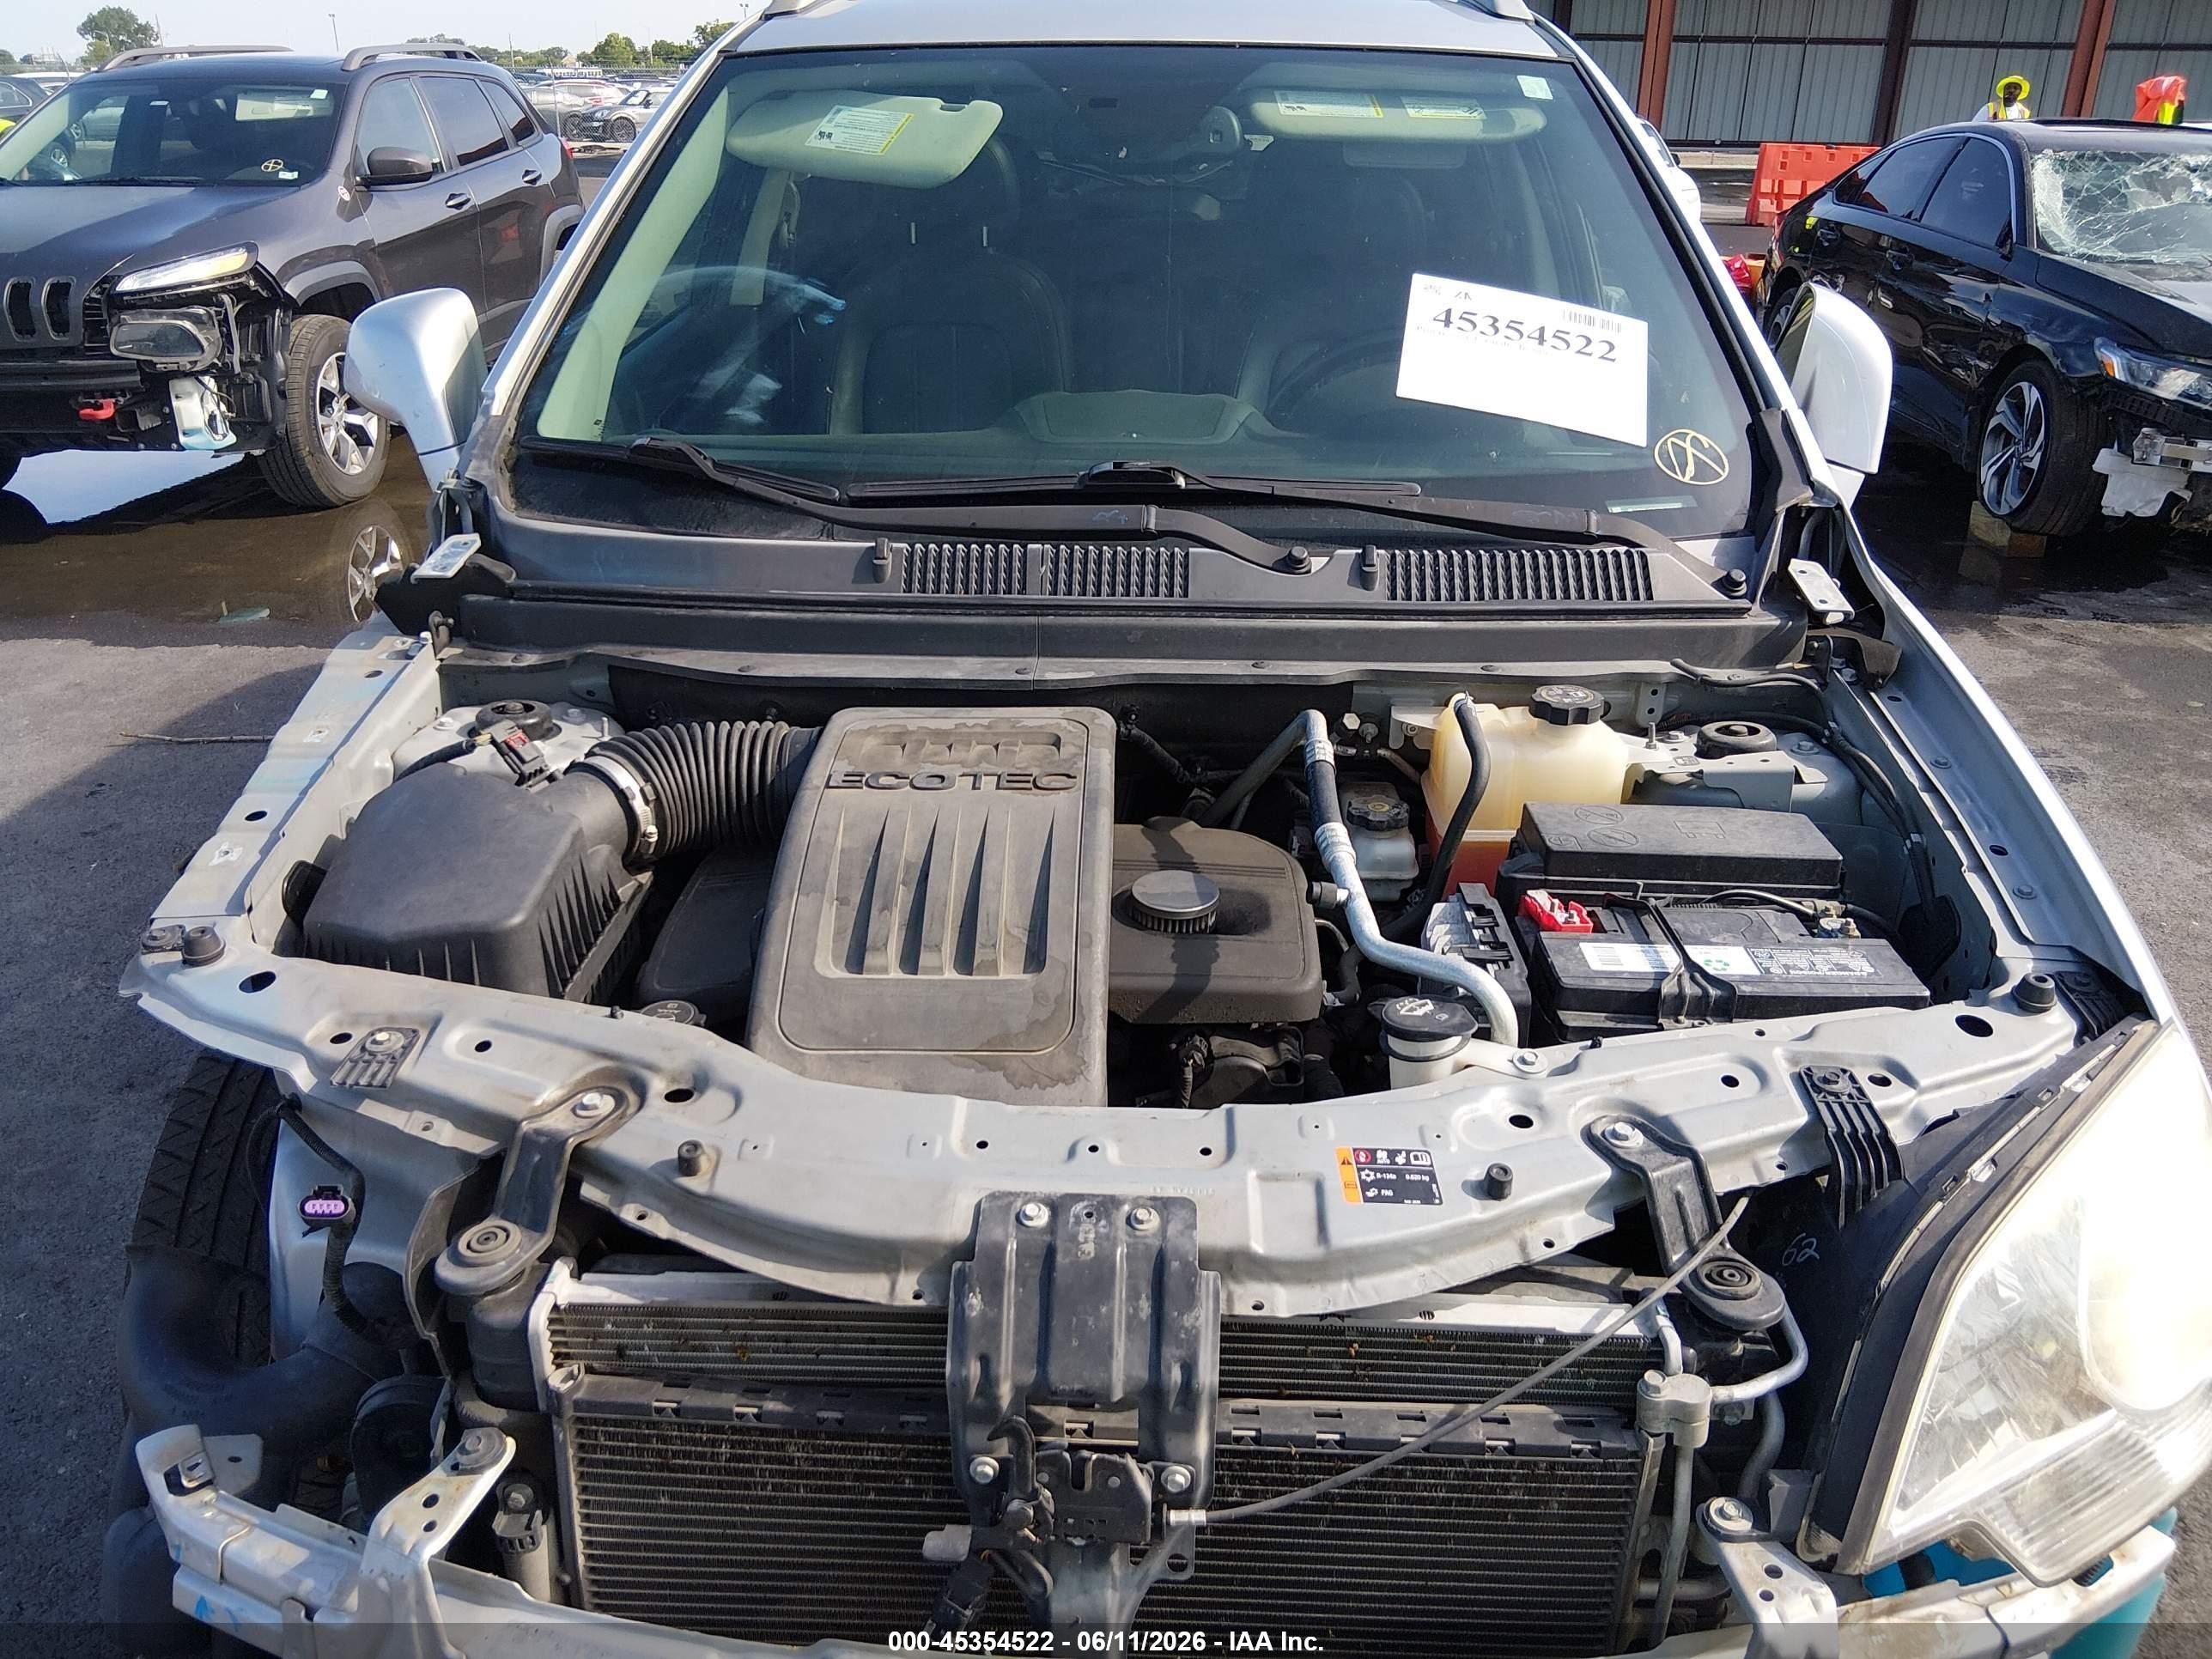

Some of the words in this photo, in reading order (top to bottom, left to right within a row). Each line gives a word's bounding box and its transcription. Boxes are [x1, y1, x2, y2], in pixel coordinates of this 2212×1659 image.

[1432, 307, 1617, 363] 45354522
[825, 770, 1078, 791] ECOTEC
[1782, 1232, 1820, 1267] 62
